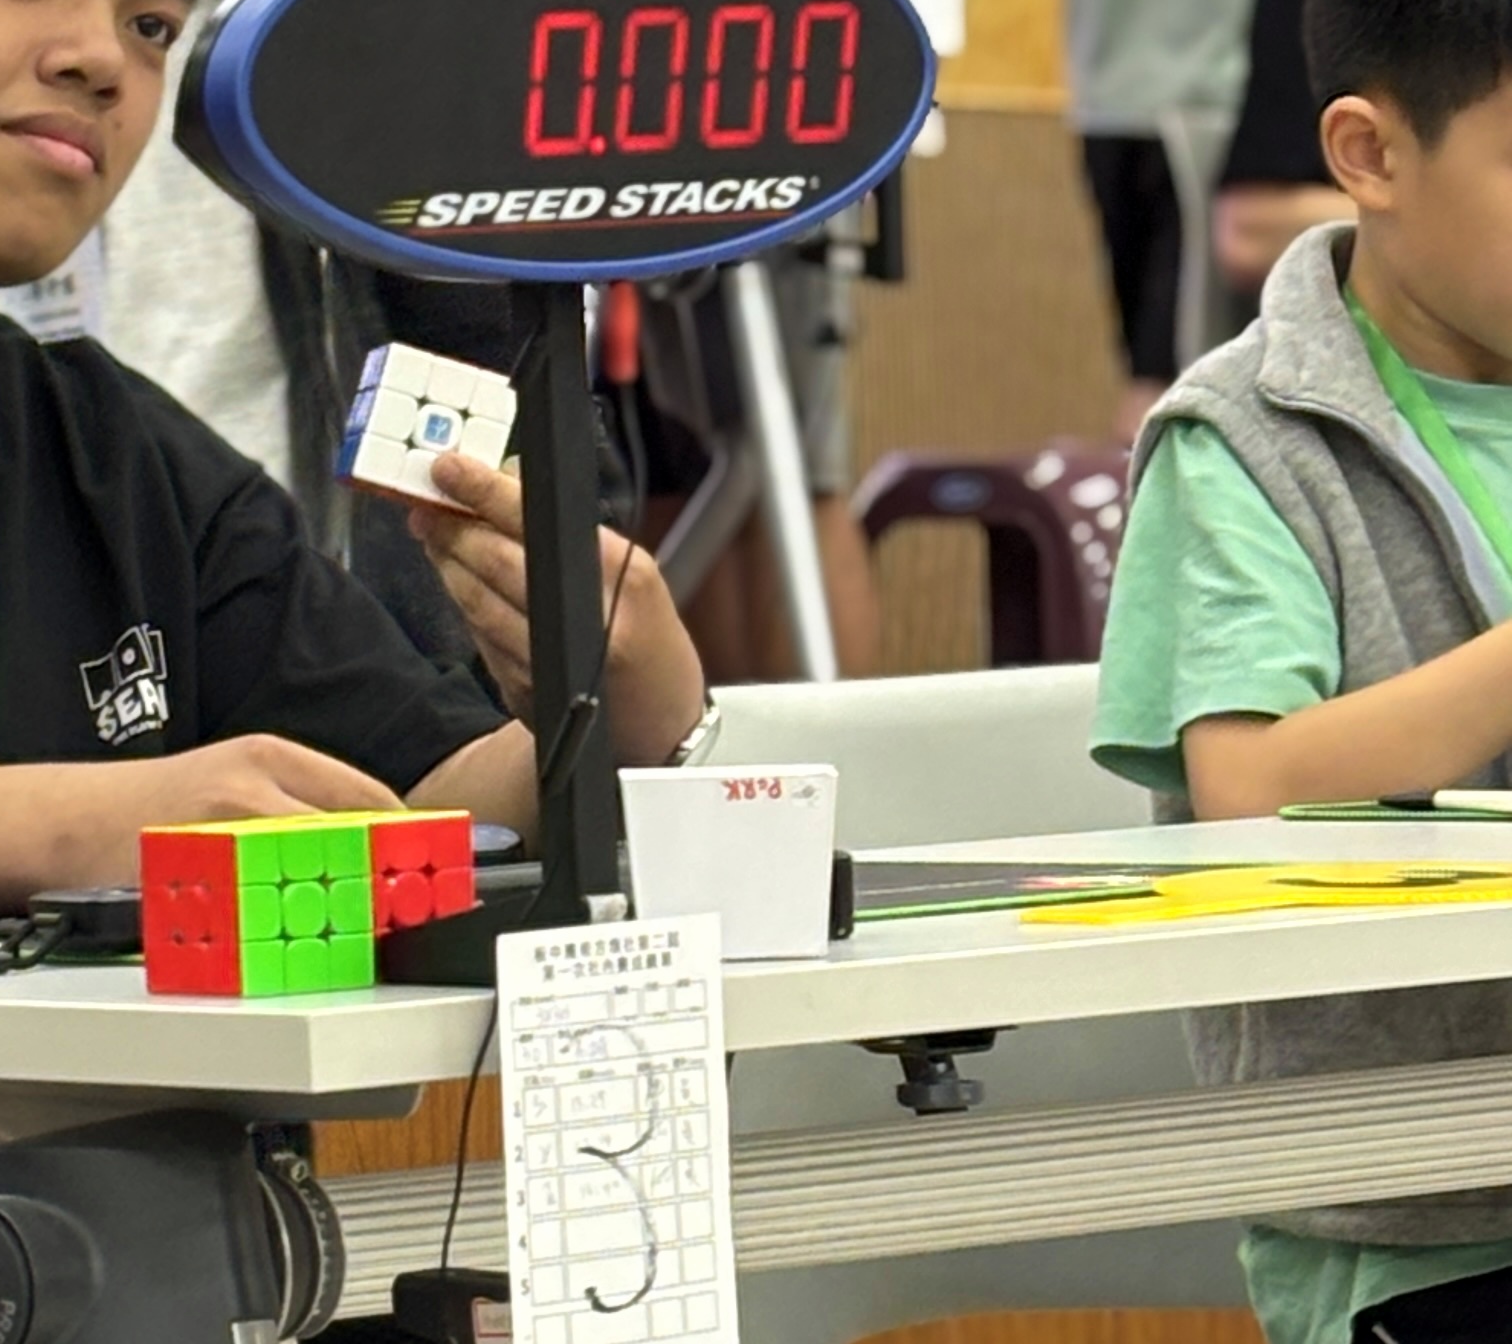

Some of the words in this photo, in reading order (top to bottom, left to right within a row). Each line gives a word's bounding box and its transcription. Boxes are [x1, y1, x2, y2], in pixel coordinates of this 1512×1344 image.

[523, 0, 860, 158] 0.000
[417, 186, 607, 227] SPEED
[609, 176, 807, 220] STACKS
